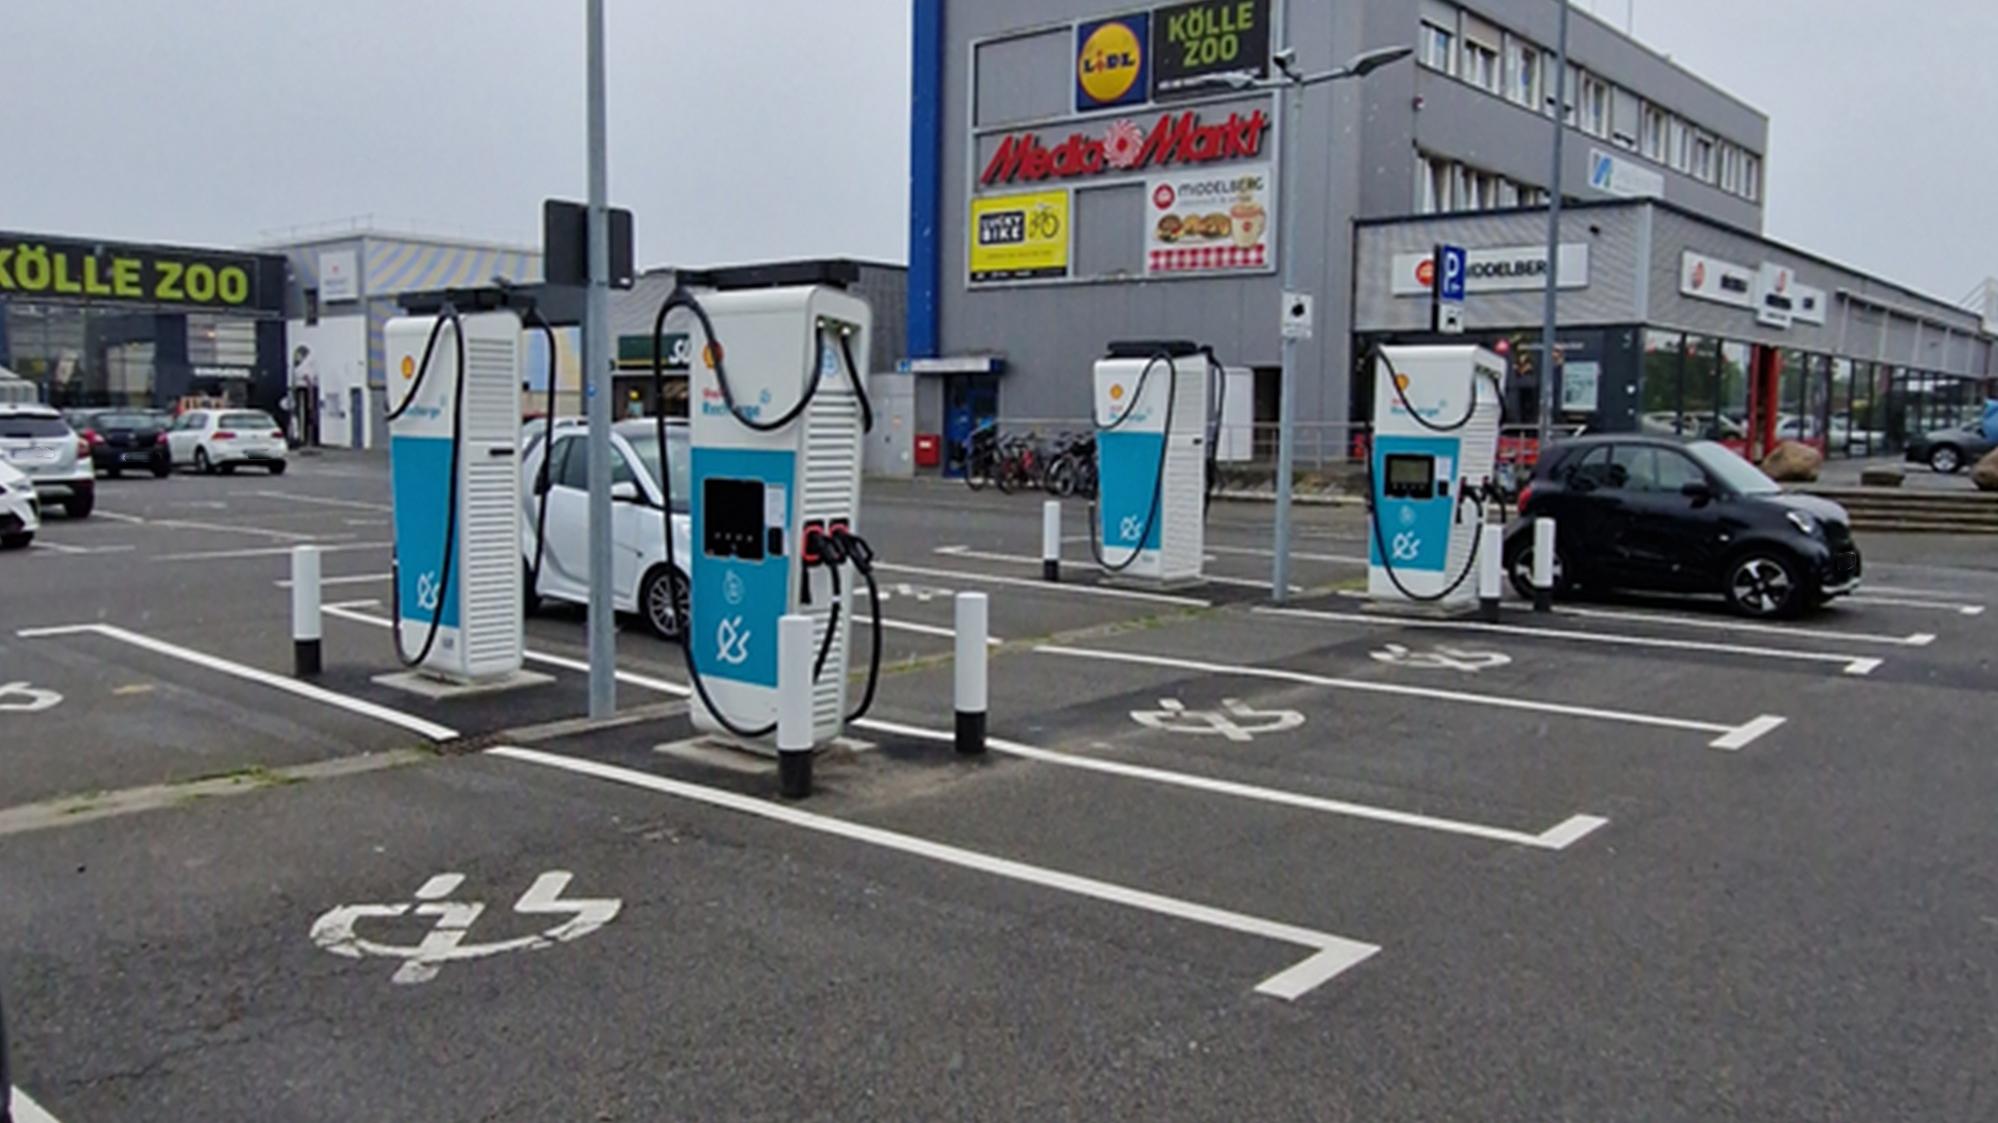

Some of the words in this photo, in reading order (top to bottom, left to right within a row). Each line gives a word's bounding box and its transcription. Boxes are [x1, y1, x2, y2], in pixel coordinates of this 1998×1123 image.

[1168, 3, 1254, 42] KÖLLE
[1183, 34, 1239, 66] ZOO
[980, 132, 1106, 184] Media
[1133, 109, 1265, 168] Markt
[982, 225, 1021, 241] BIKE
[155, 261, 248, 304] ZOO
